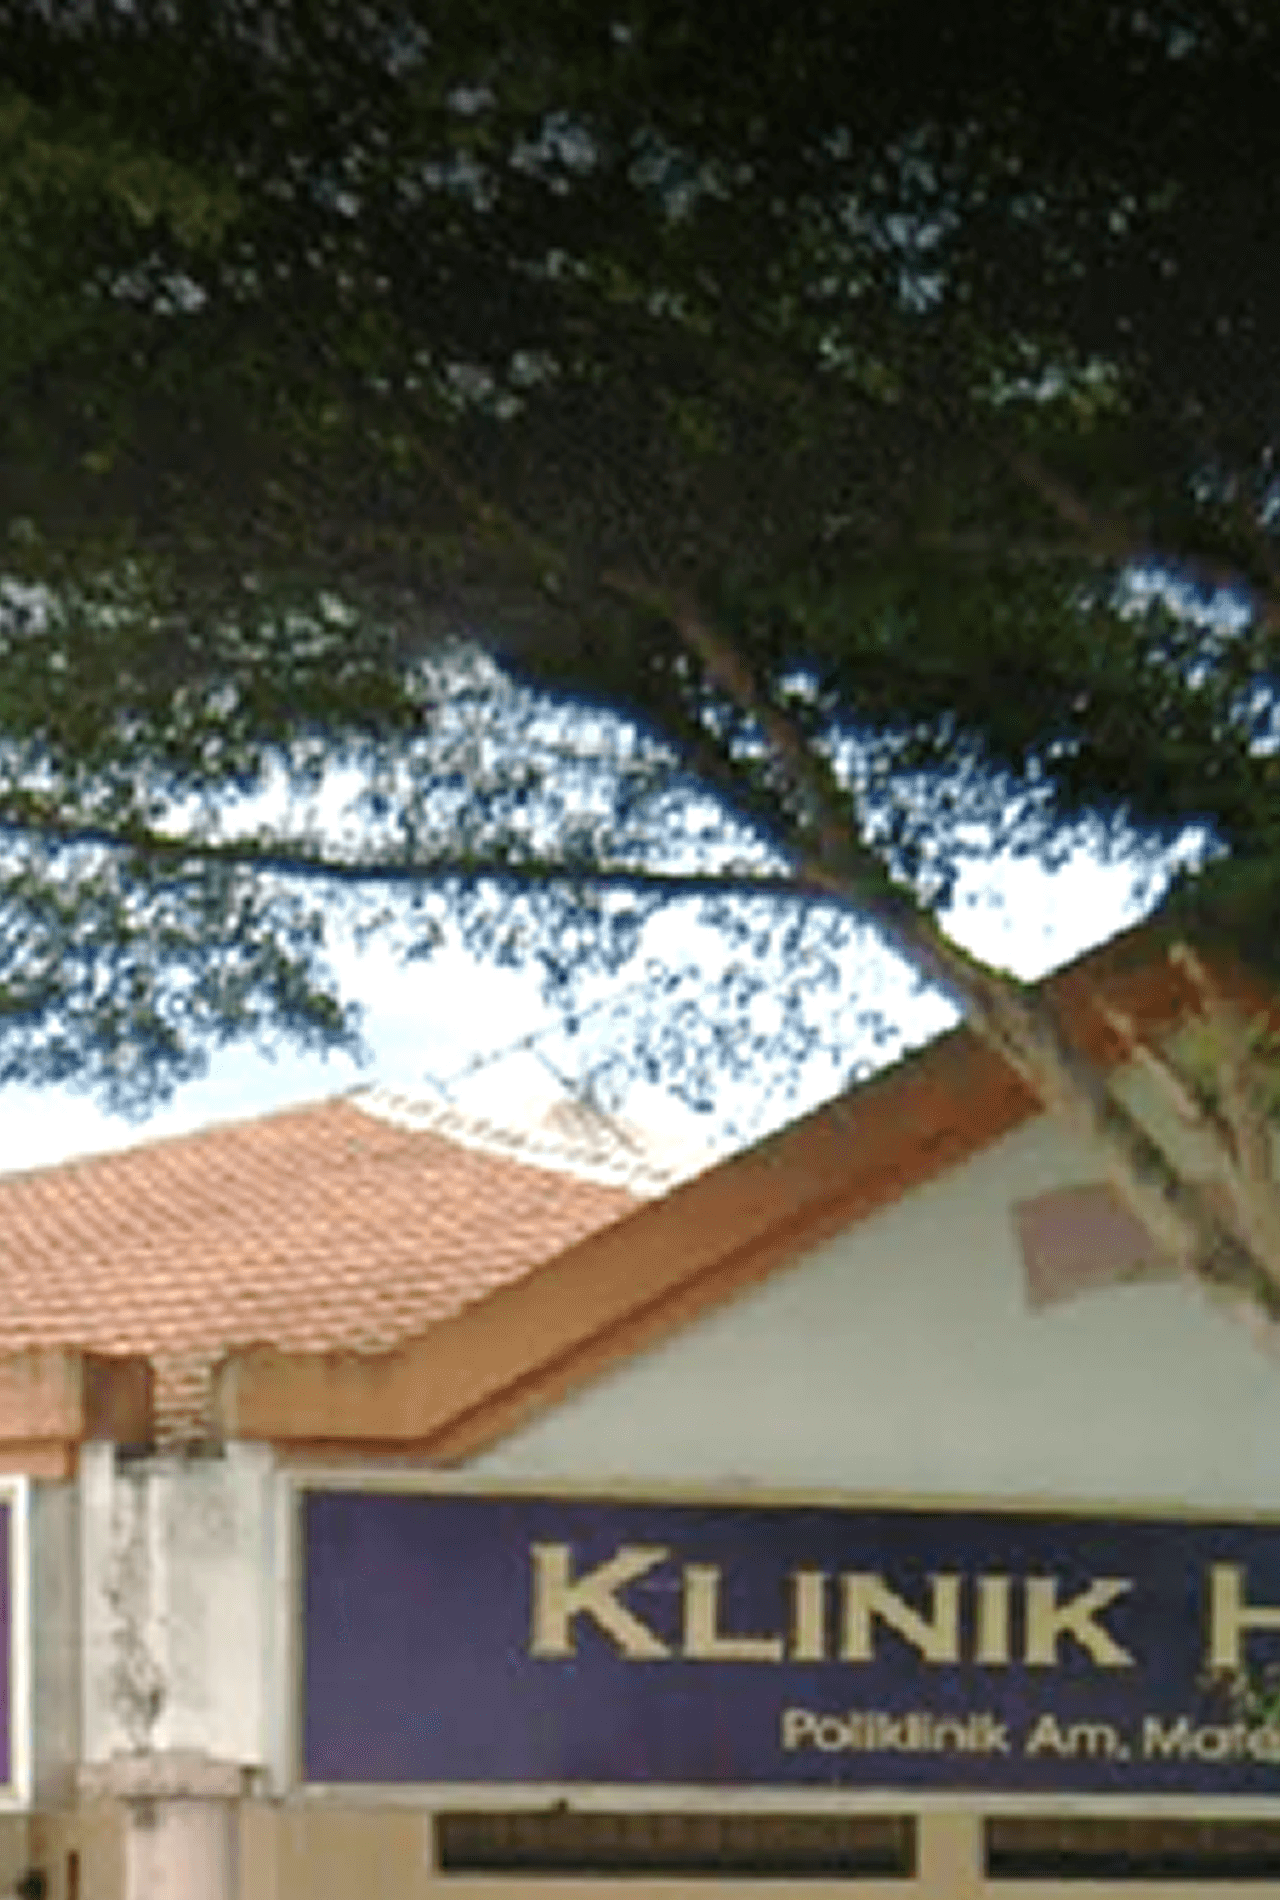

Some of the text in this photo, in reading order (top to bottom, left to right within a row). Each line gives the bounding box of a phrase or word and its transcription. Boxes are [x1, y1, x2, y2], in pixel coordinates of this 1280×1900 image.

[529, 1542, 1137, 1667] KLINIK
[780, 1708, 1012, 1754] Poliklinik
[1023, 1711, 1132, 1762] Am,
